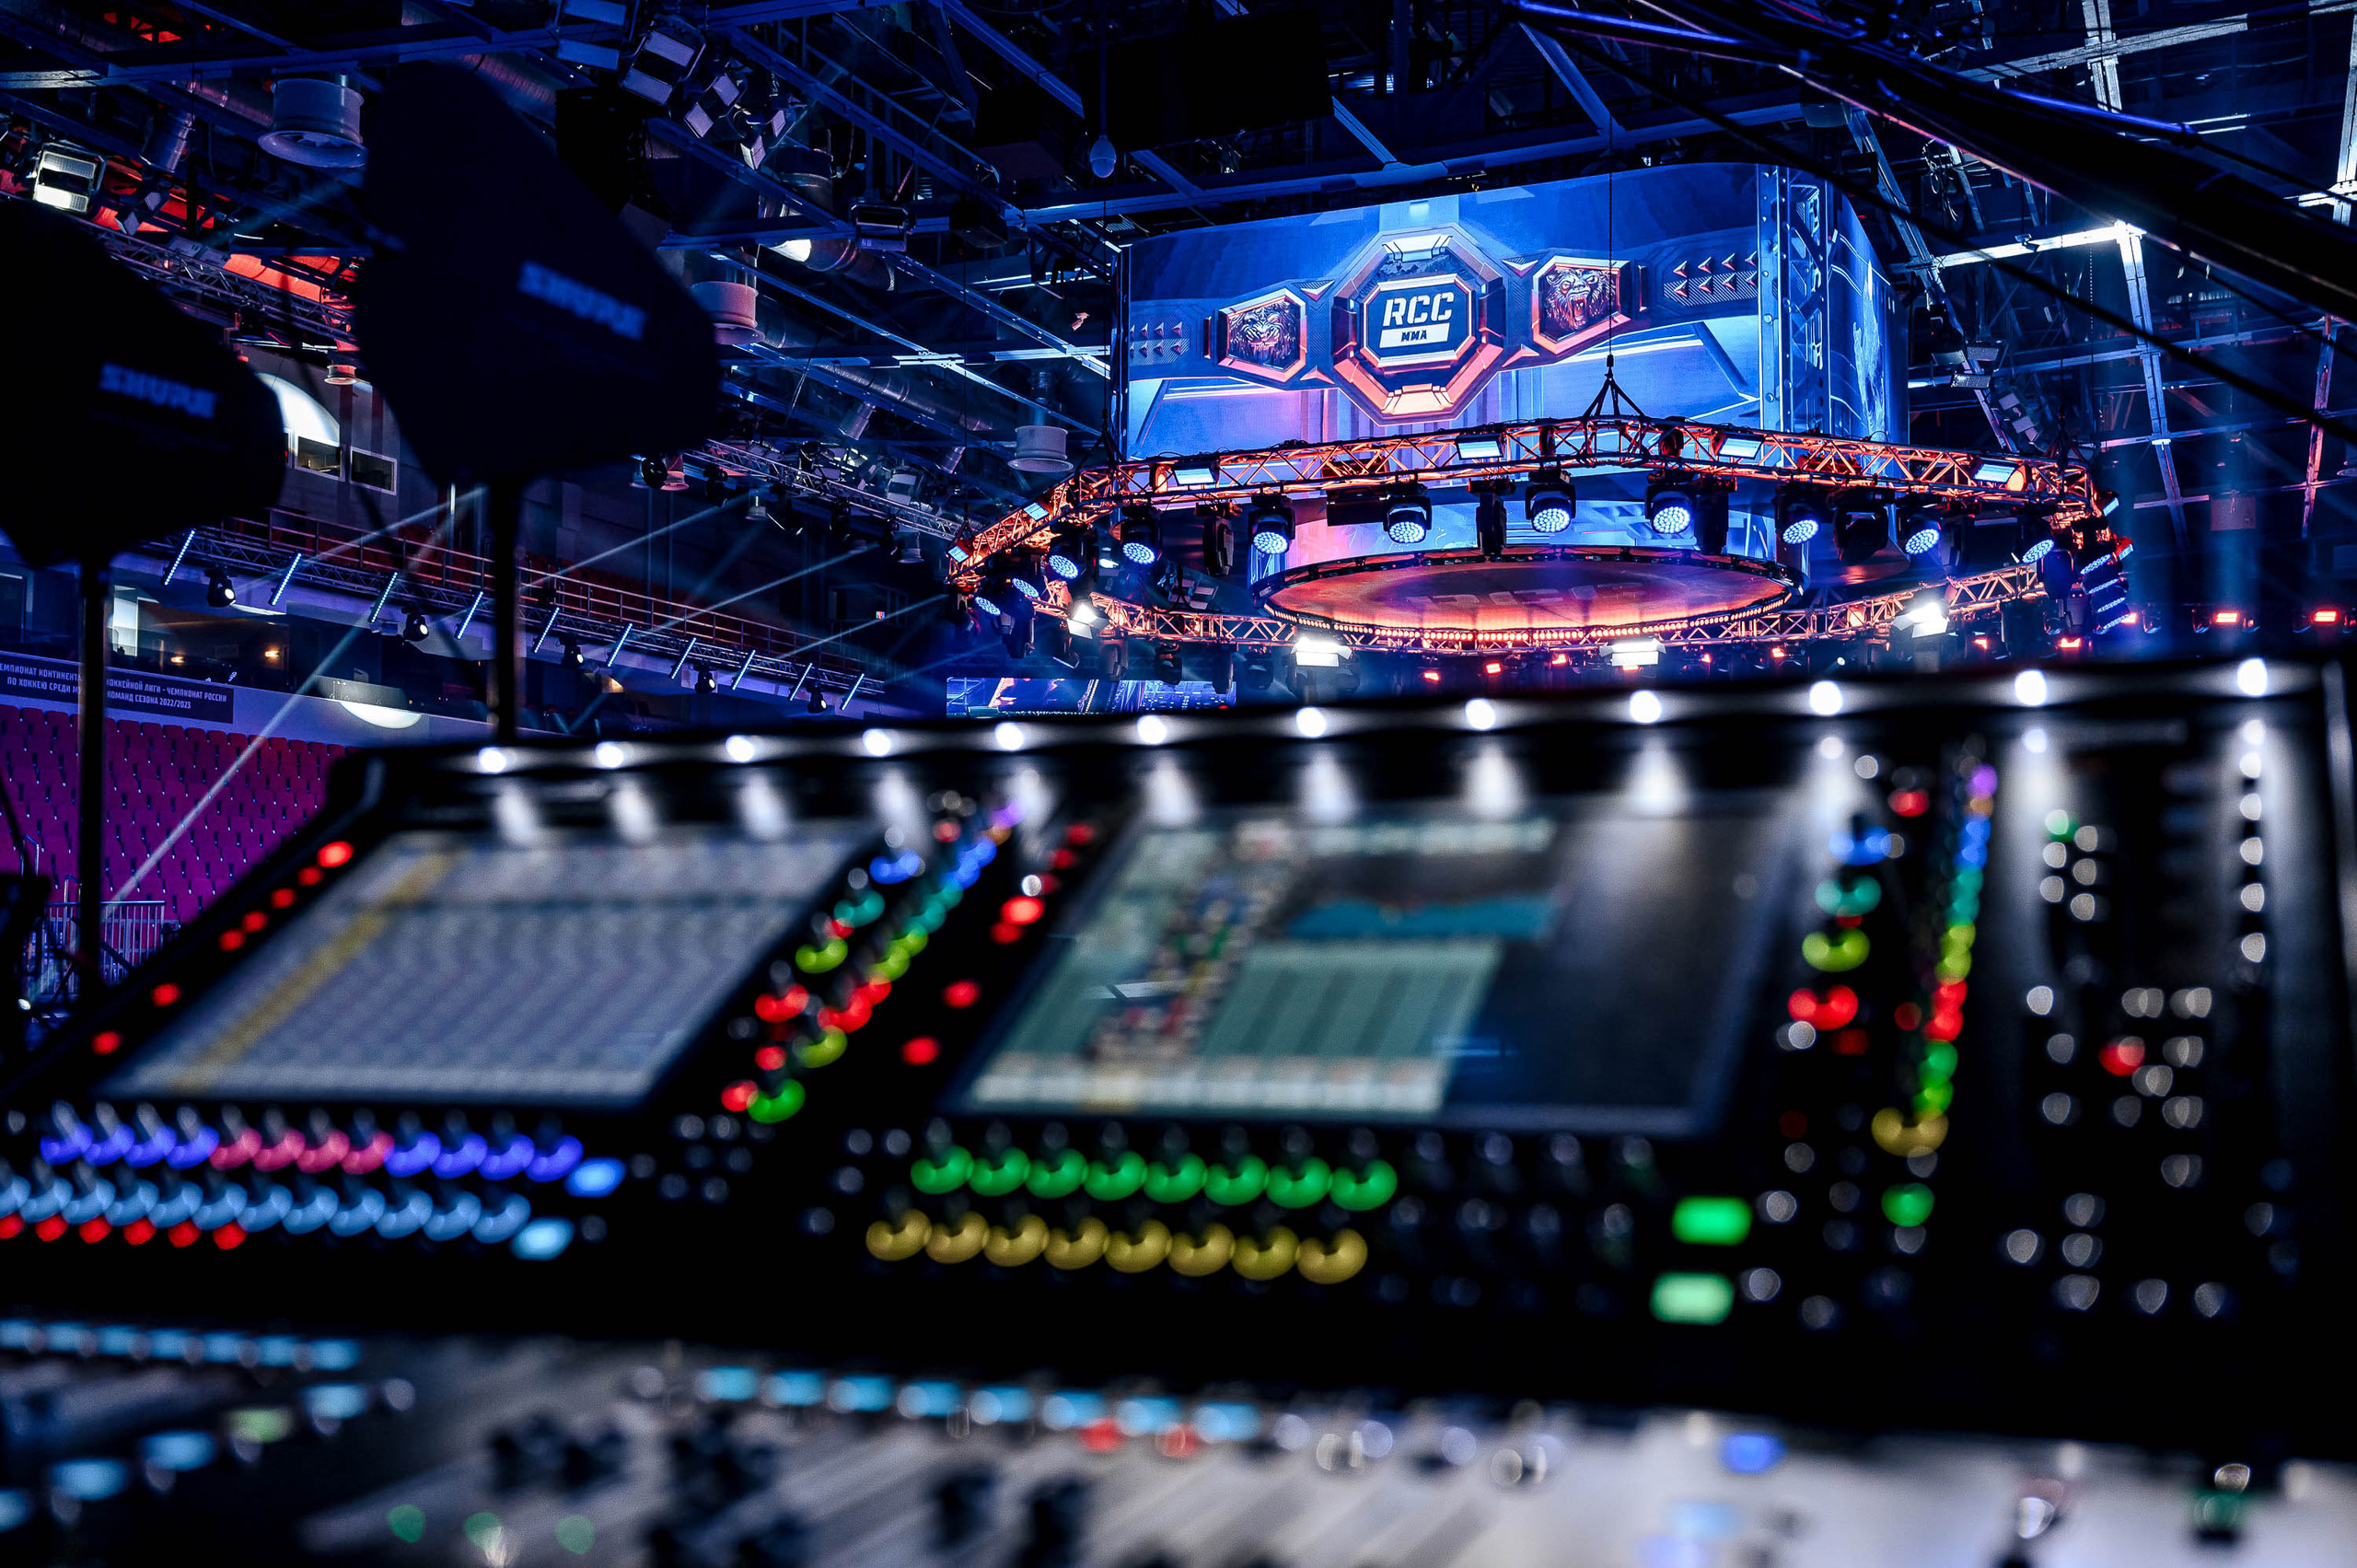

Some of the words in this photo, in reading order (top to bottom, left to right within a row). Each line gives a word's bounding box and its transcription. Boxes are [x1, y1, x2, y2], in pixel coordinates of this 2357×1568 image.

[1383, 292, 1454, 326] RCC
[1401, 330, 1427, 342] MMA
[0, 663, 37, 675] ЕМПИОНАТ
[106, 678, 143, 690] ХОККЕЙНОЙ
[145, 684, 161, 693] ЛИГИ
[167, 687, 203, 700] ЧЕМПИОНАТ
[204, 692, 226, 703] РОССИИ
[7, 677, 17, 685] ПО
[18, 679, 47, 690] ХОККЕЮ
[49, 682, 71, 693] СРЕДИ
[107, 691, 134, 703] КОМАНД
[135, 695, 158, 705] СЕЗОНА
[159, 698, 192, 709] 2022/2023
